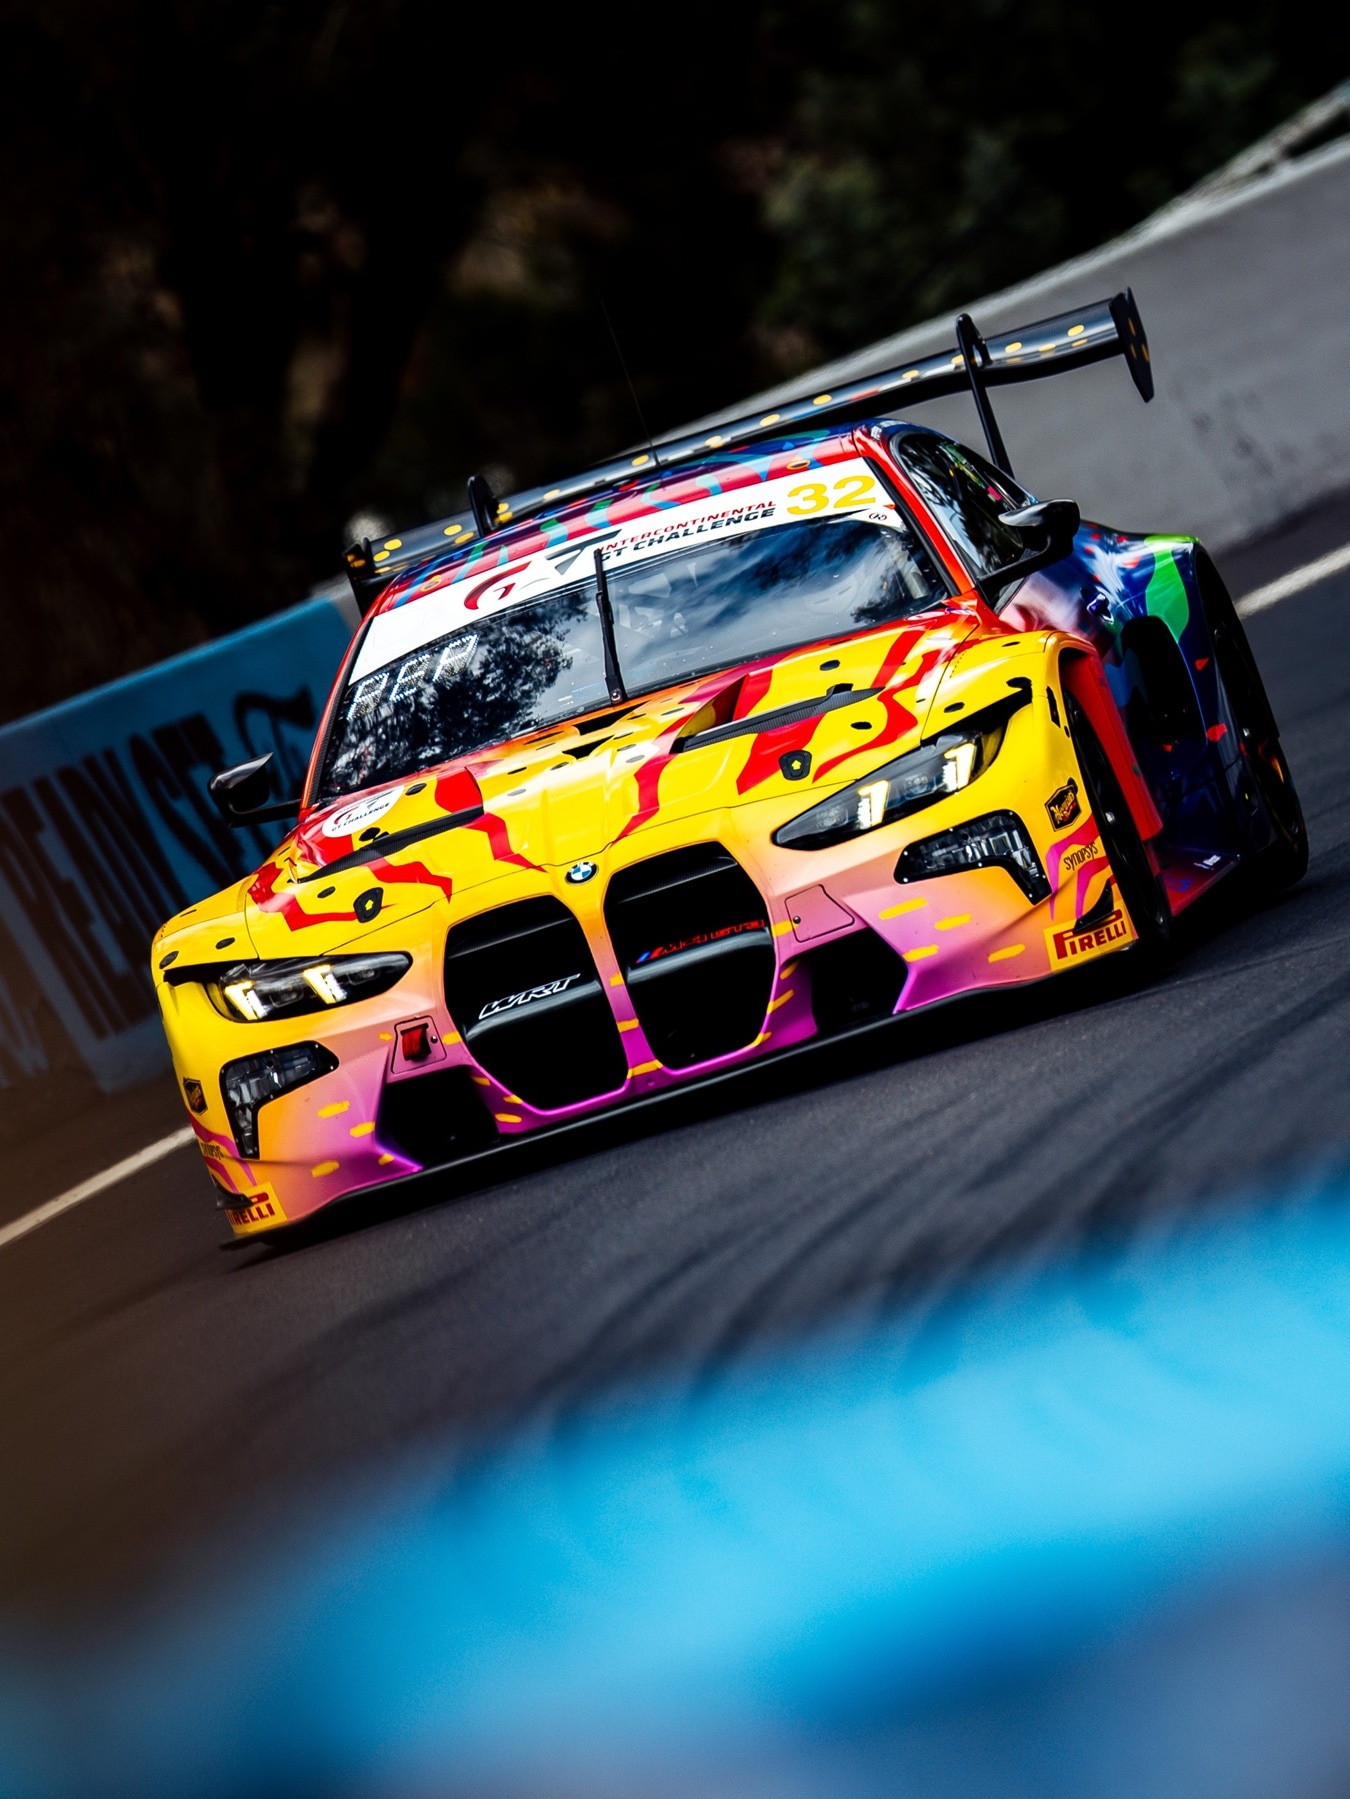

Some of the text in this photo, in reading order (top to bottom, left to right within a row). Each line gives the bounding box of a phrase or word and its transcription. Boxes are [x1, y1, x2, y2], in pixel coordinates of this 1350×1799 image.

[786, 474, 877, 516] 32
[601, 500, 777, 553] INTERCONTINENTAL
[632, 507, 776, 552] CHALLENGE
[1063, 842, 1098, 870] SYNOPSYS
[1052, 908, 1127, 960] PIRELLI
[478, 972, 581, 1020] WRT
